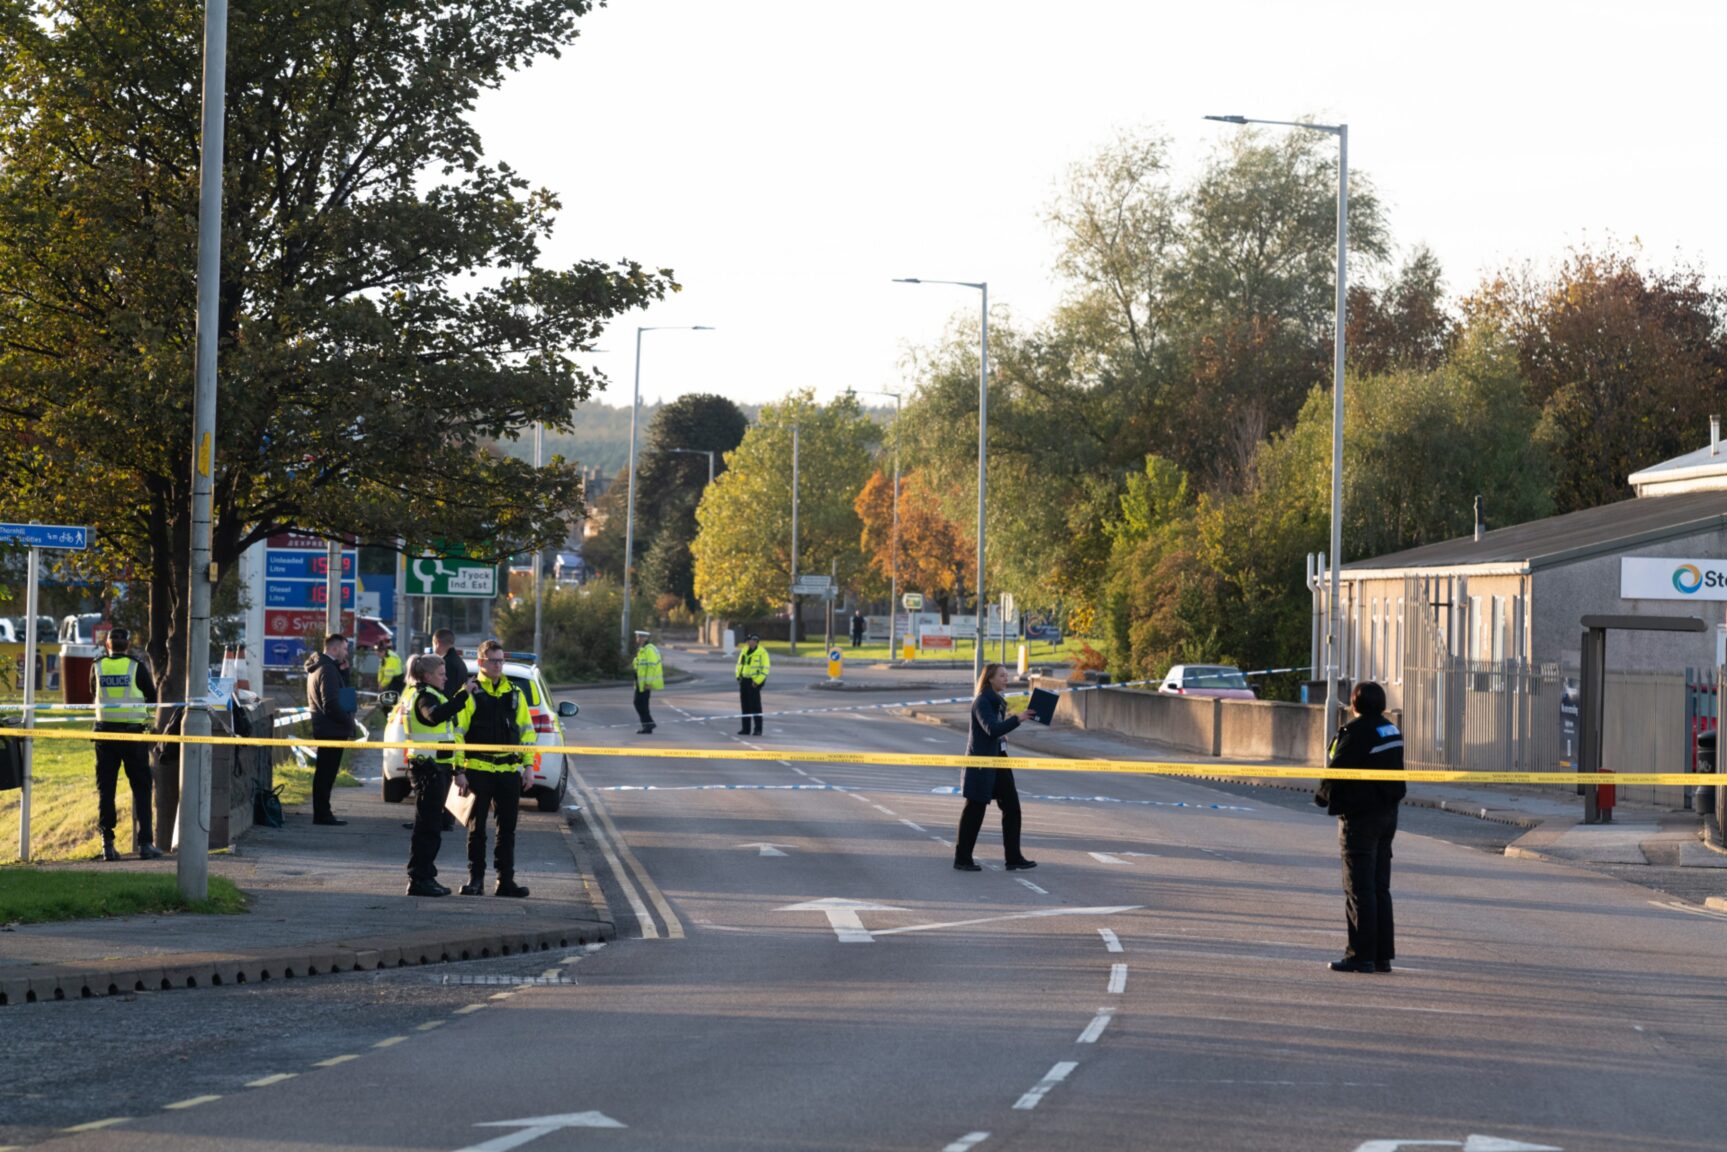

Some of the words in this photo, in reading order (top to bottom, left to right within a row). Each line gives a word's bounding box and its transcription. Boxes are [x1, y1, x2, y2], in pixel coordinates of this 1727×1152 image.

[270, 556, 304, 564] Unleaded
[462, 570, 490, 580] Tyock
[101, 675, 130, 686] POLICE
